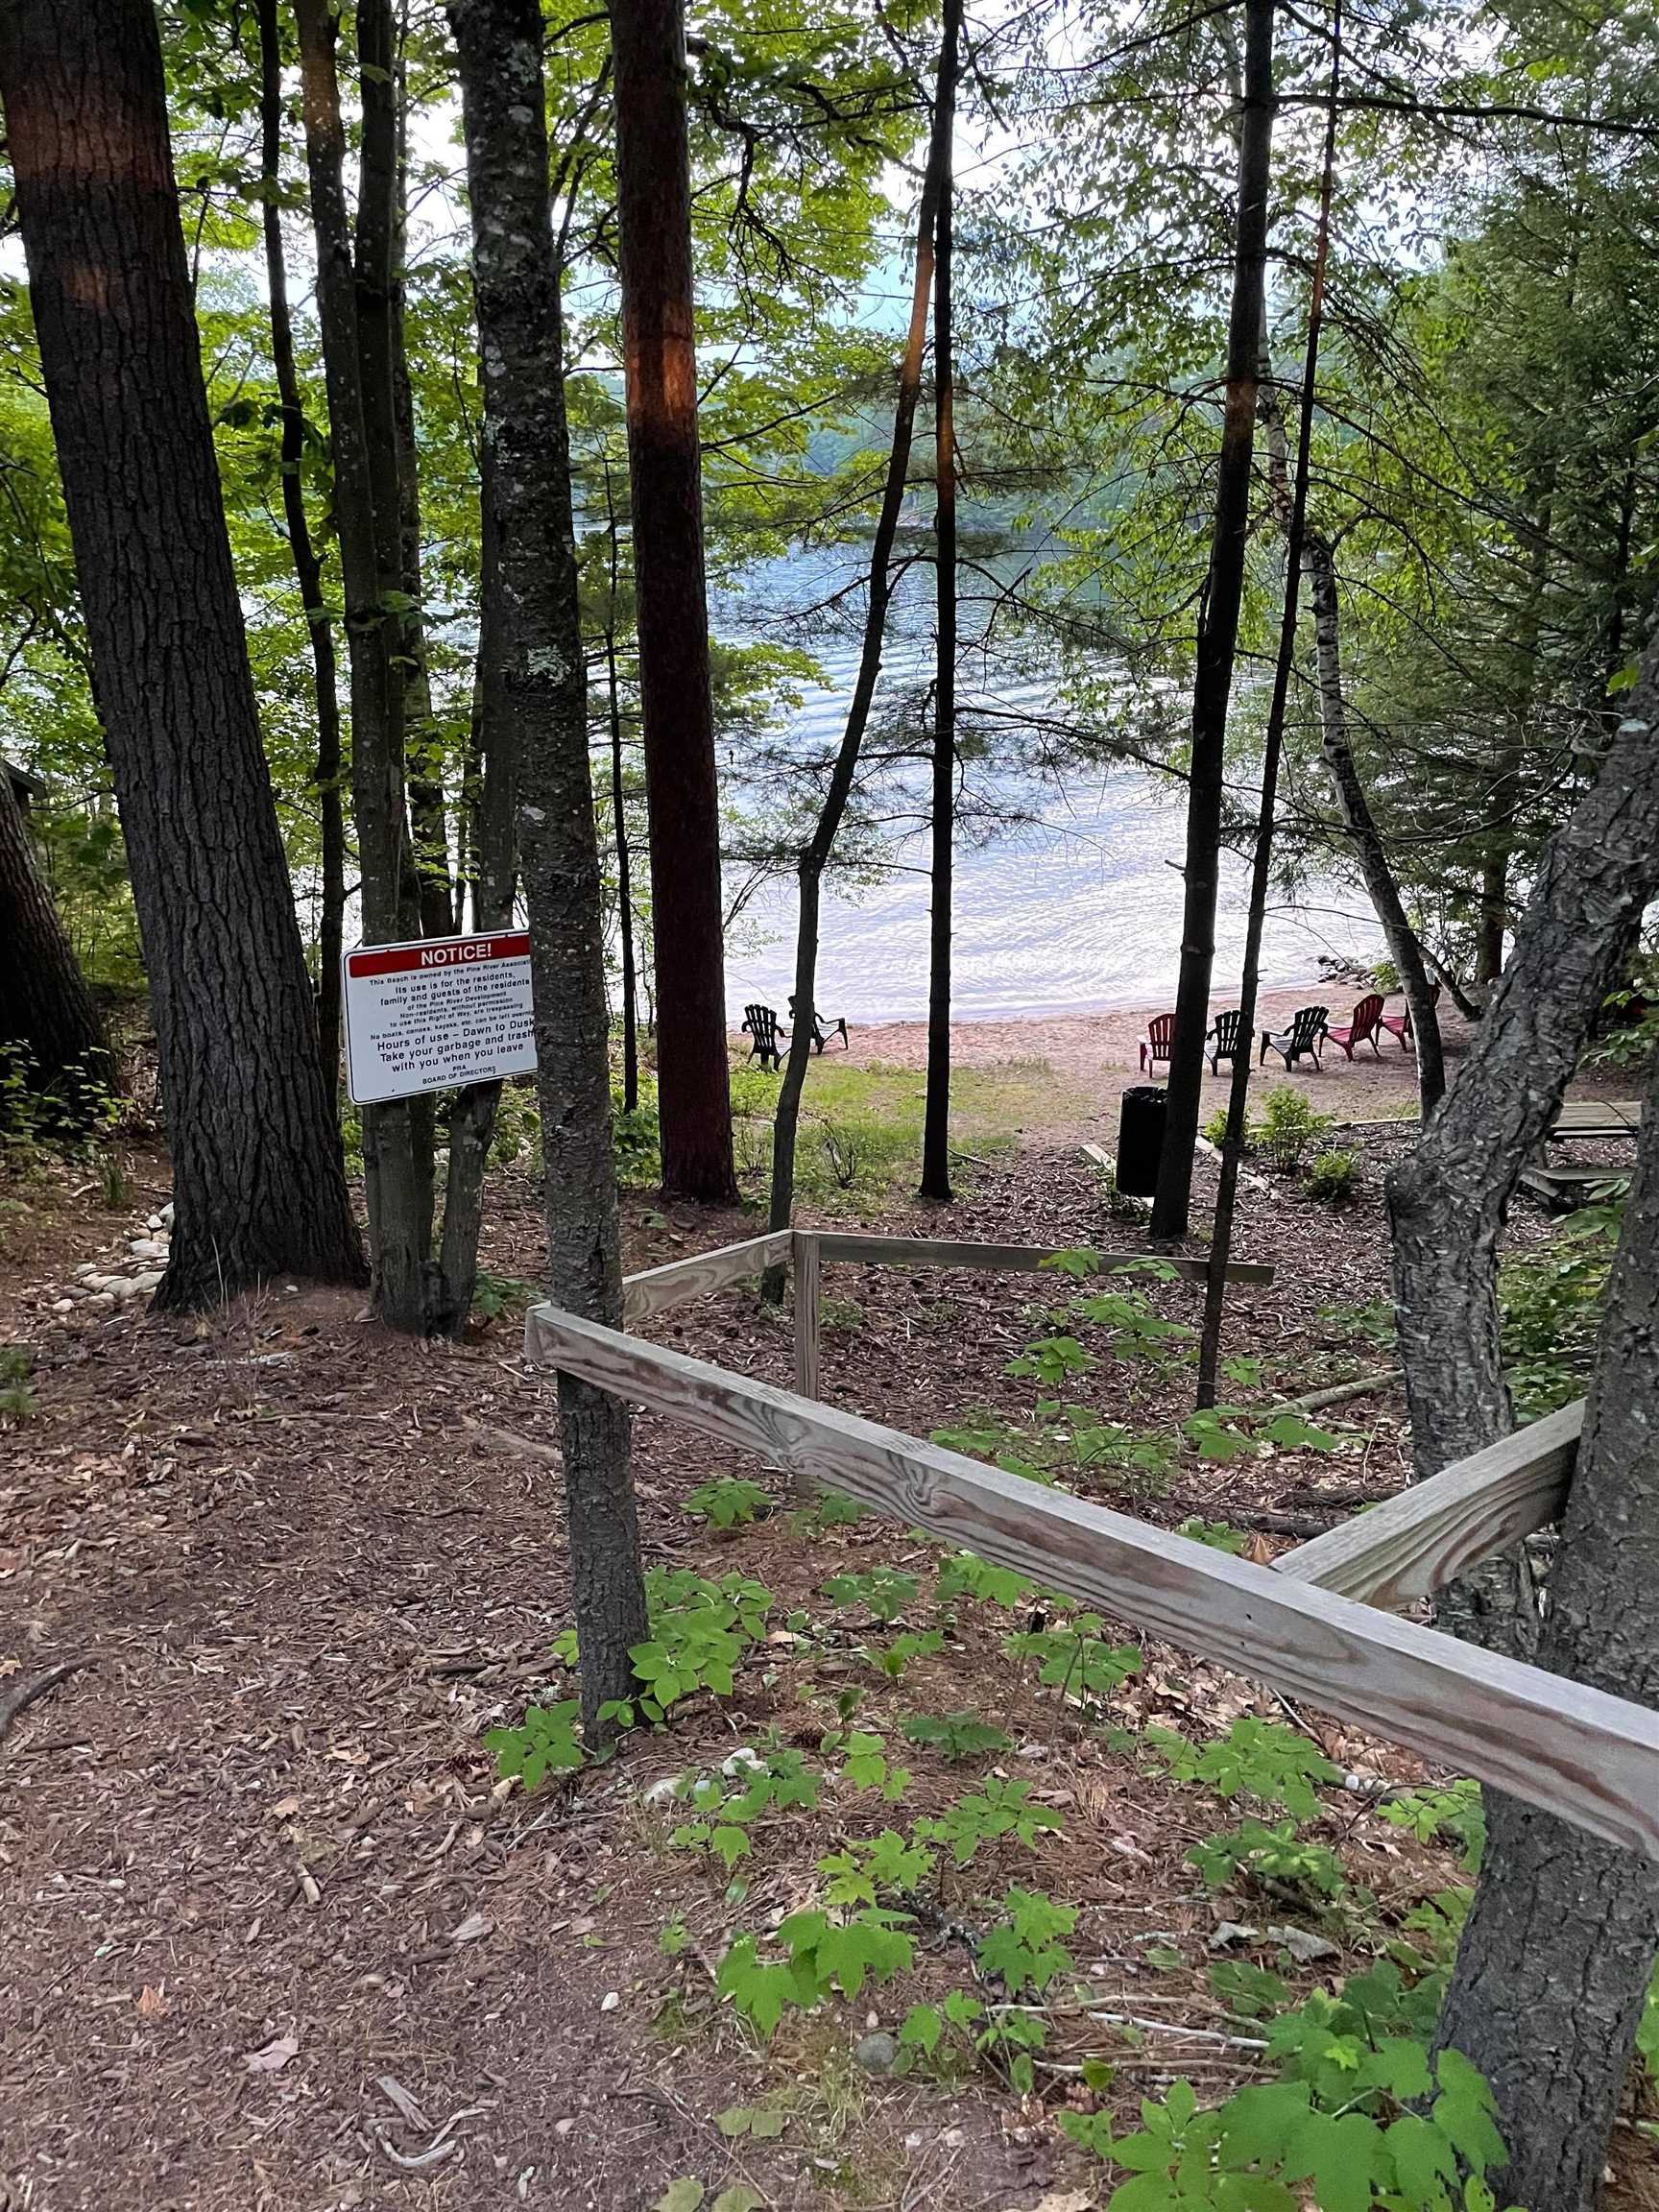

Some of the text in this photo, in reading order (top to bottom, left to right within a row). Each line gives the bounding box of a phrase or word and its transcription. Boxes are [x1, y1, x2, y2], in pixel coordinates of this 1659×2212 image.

[421, 943, 492, 966] NOTICE!
[387, 975, 409, 984] Beach
[396, 986, 407, 995] Its
[441, 979, 452, 988] for
[456, 977, 470, 986] the
[380, 996, 408, 1007] family
[411, 993, 427, 1001] and
[430, 988, 461, 1001] guests
[474, 984, 488, 993] the
[491, 978, 530, 990] residents
[465, 991, 507, 1002] Development
[429, 1014, 446, 1022] Right
[486, 1003, 523, 1013] trespassing
[451, 1002, 476, 1011] without
[477, 998, 513, 1008] permission
[377, 1039, 411, 1052] Hours
[415, 1034, 425, 1045] of
[429, 1033, 449, 1043] use
[463, 1025, 492, 1038] Dawn
[495, 1023, 505, 1032] to
[510, 1018, 535, 1029] Dusk
[380, 1028, 535, 1063] Take your garbage and trash
[392, 1044, 523, 1073] with you when you leave
[422, 1074, 446, 1085] BOARD
[459, 1065, 496, 1077] DIRECTORS
